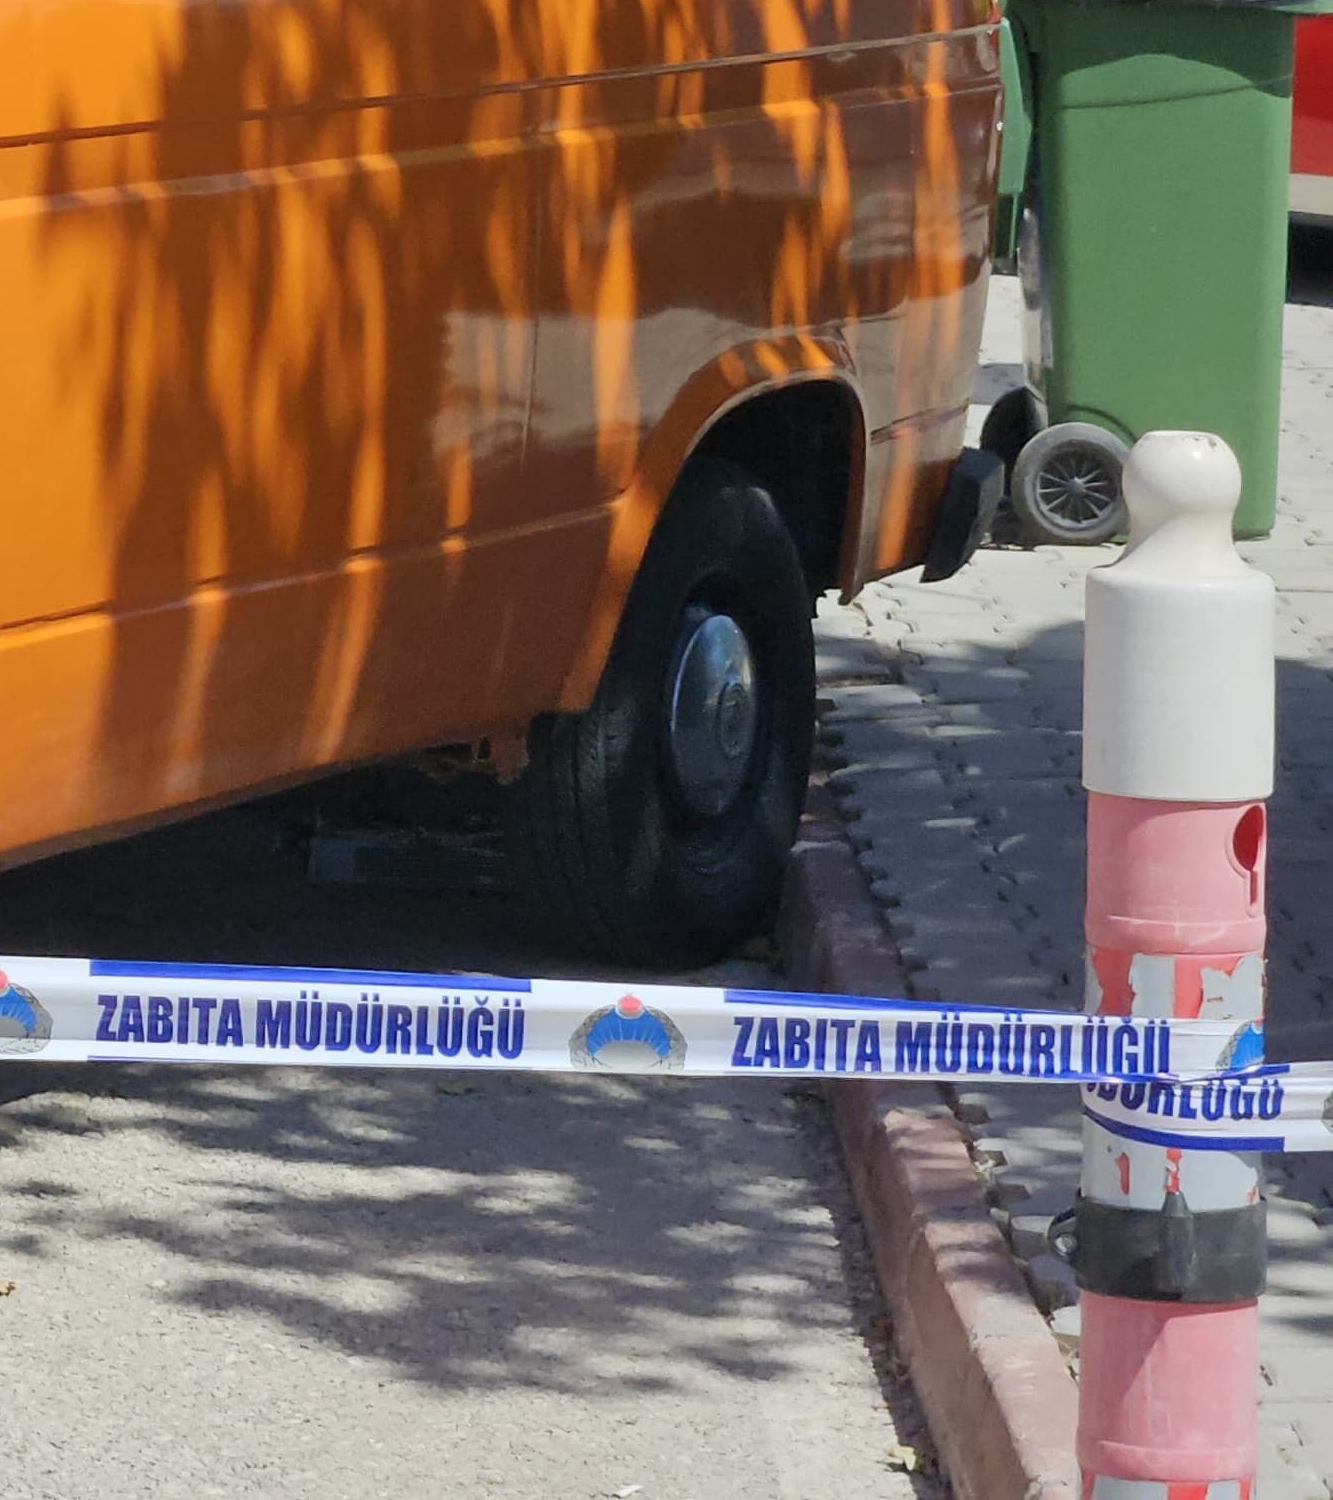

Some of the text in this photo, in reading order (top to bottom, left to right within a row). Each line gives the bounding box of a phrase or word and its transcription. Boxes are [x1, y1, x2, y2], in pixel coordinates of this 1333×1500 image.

[95, 990, 526, 1060] ZABITA MÜDÜRLÜĞÜ
[730, 1015, 882, 1074] ZABITA
